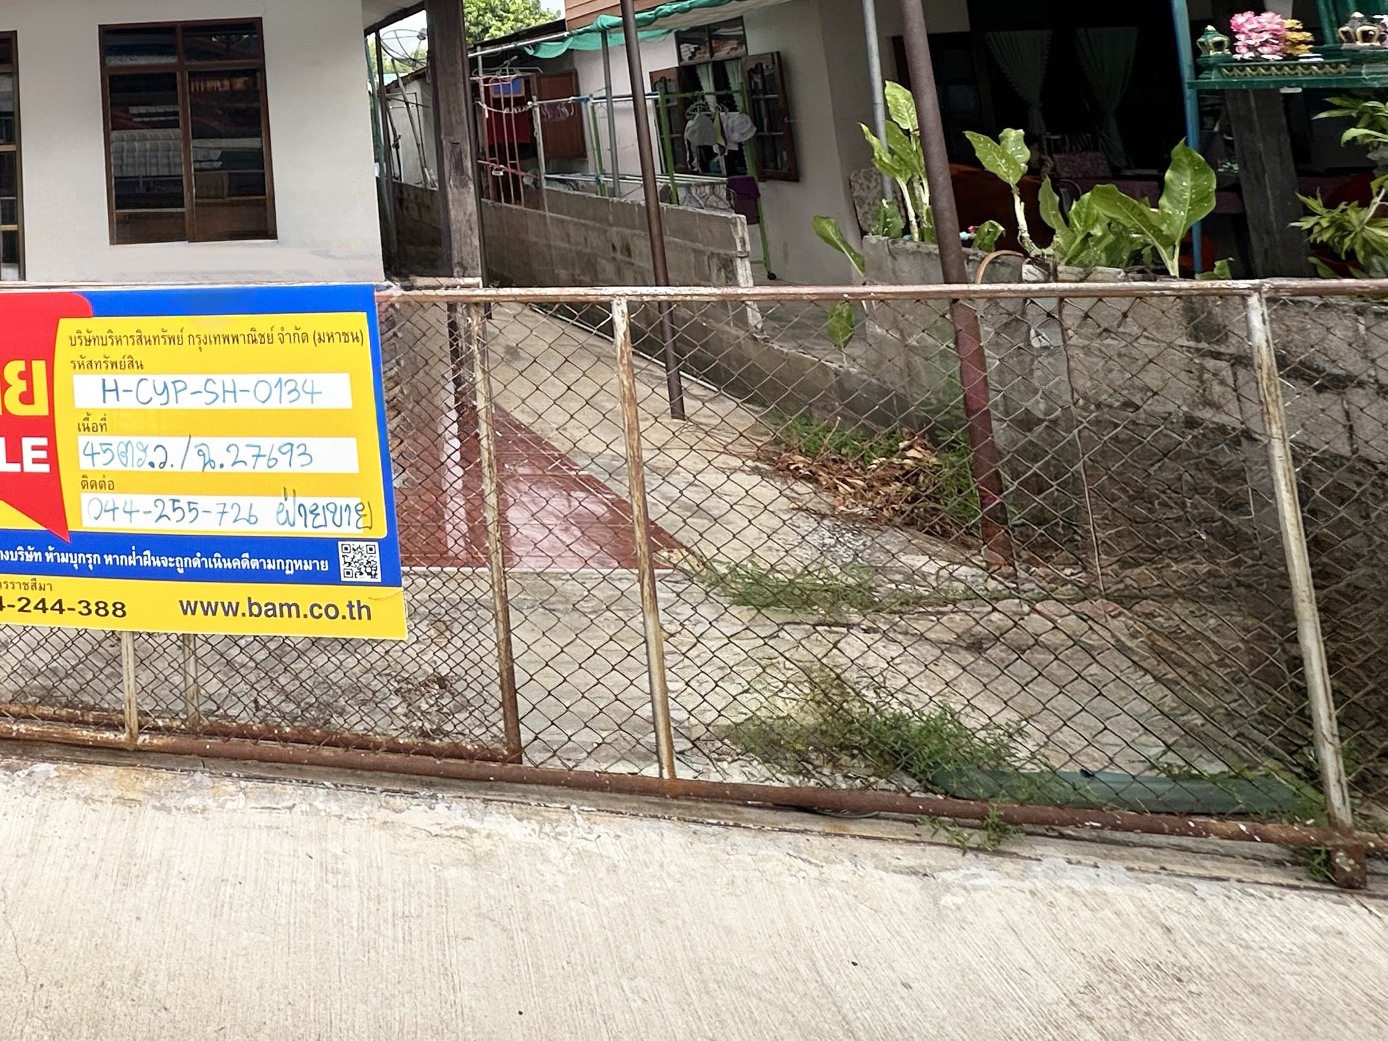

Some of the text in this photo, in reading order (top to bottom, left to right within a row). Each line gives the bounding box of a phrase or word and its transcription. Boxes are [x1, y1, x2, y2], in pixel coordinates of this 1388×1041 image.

[68, 325, 365, 352] บริษัทบริหารสินทรัพย์ กรุงเทพพาณิชย์ จำกัด (มหาชน)
[70, 353, 145, 371] รหัสทรัพย์สิน
[77, 412, 108, 434] เนื้อที่
[80, 475, 116, 492] ติดต่อ
[87, 496, 259, 527] 044-255-726
[44, 545, 101, 571] ห้ามบุกรุก
[178, 596, 372, 622] www.bam.co.th
